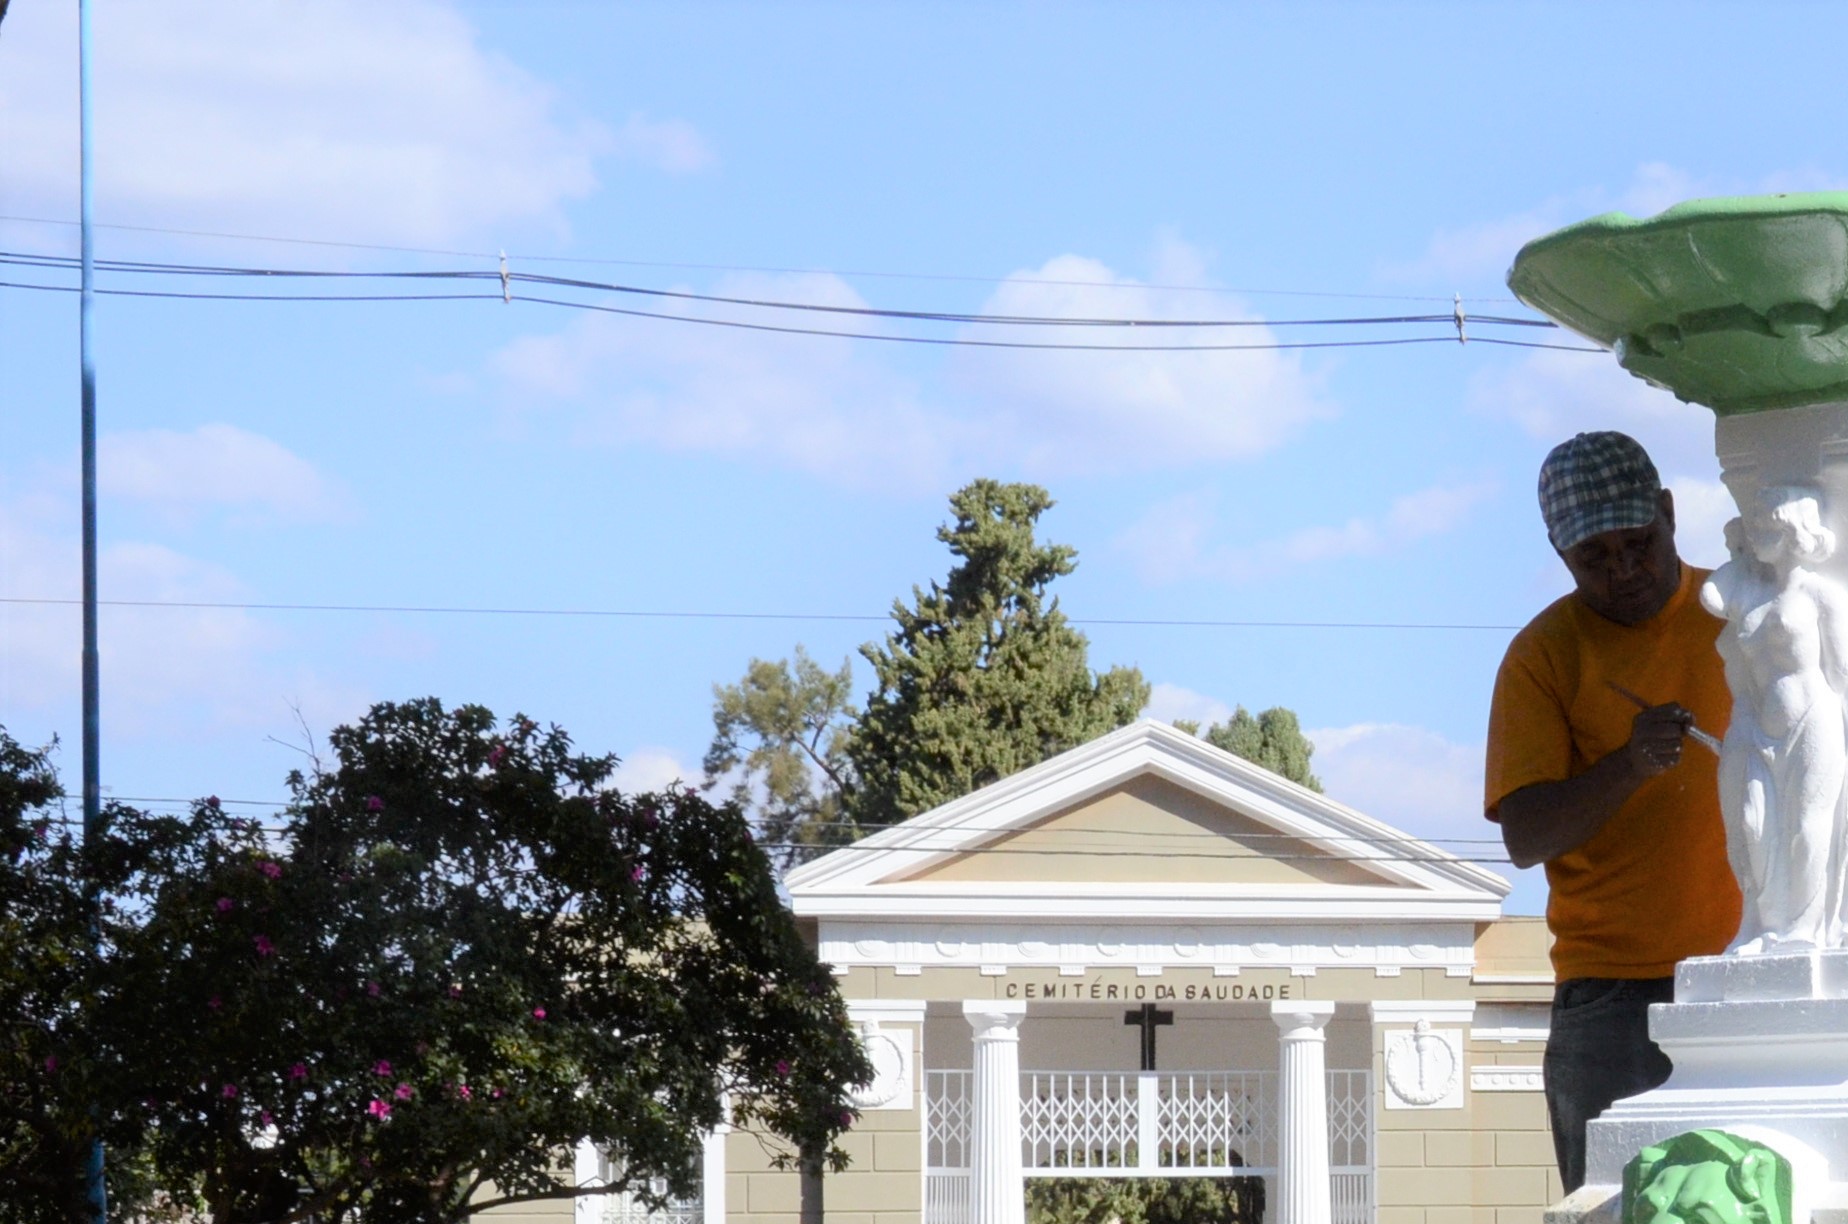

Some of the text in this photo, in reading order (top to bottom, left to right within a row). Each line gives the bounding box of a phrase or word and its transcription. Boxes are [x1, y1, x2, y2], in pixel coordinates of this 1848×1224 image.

[1006, 975, 1290, 1000] CEMITÉRIO DA SAUDADE
